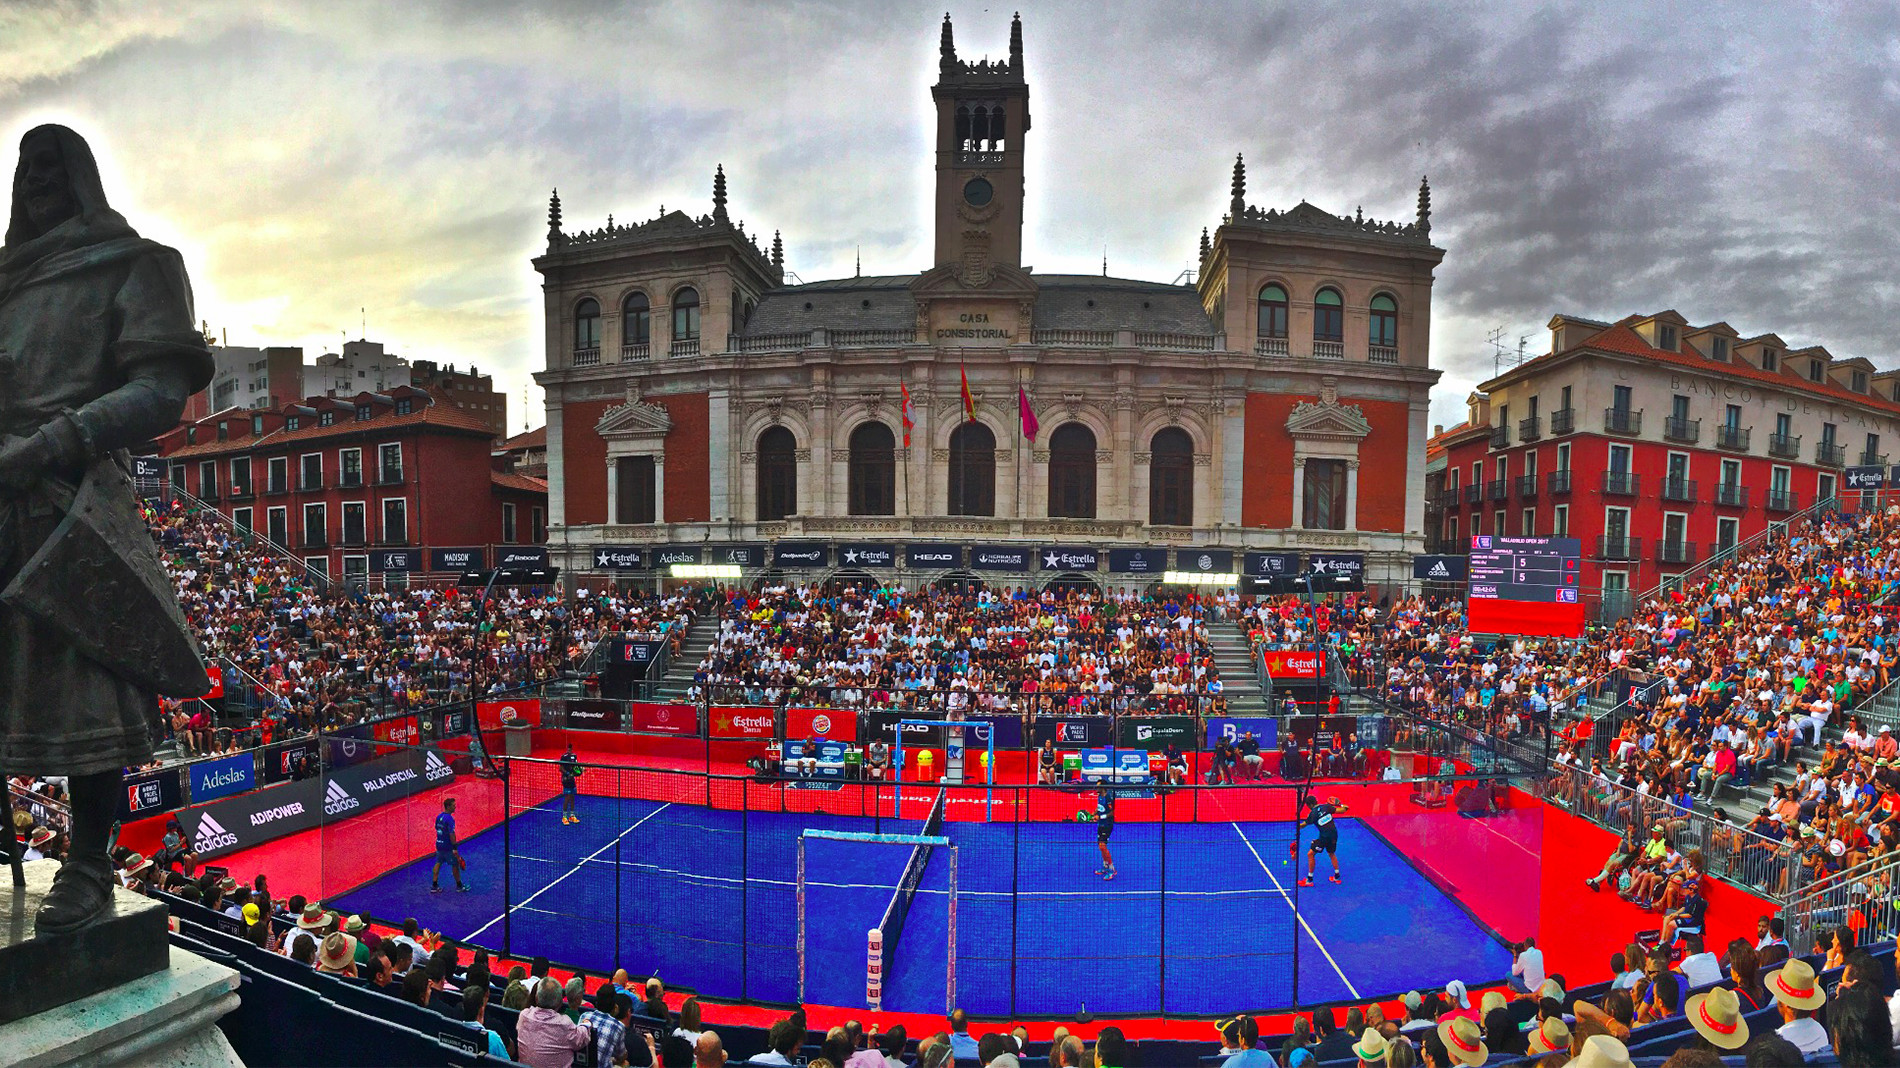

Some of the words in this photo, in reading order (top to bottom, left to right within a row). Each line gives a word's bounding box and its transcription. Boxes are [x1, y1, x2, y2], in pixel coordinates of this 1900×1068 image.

[960, 313, 989, 323] CASA
[937, 328, 1011, 338] CONSISTORIAL
[1671, 375, 1752, 403] BANCO
[1787, 398, 1810, 415] DE
[1859, 473, 1882, 482] Estrella
[444, 553, 469, 562] MADISON
[611, 552, 640, 562] Estrella
[659, 552, 694, 563] Adeslas
[860, 550, 890, 560] Estrella
[1061, 553, 1096, 563] Estrella
[1328, 560, 1360, 570] Estrella
[1520, 558, 1526, 567] 5
[1566, 560, 1574, 569] 0
[1519, 573, 1525, 581] 5
[1566, 575, 1573, 584] 0
[733, 716, 772, 728] Estrella
[882, 723, 929, 733] HEAD
[426, 765, 453, 781] adidas
[201, 767, 245, 791] Adeslas
[362, 776, 386, 793] PALA
[385, 768, 417, 786] OFICIAL
[324, 796, 360, 815] adidas
[250, 802, 305, 826] ADIPOWER
[194, 832, 238, 854] adidas
[654, 1030, 660, 1039] 6
